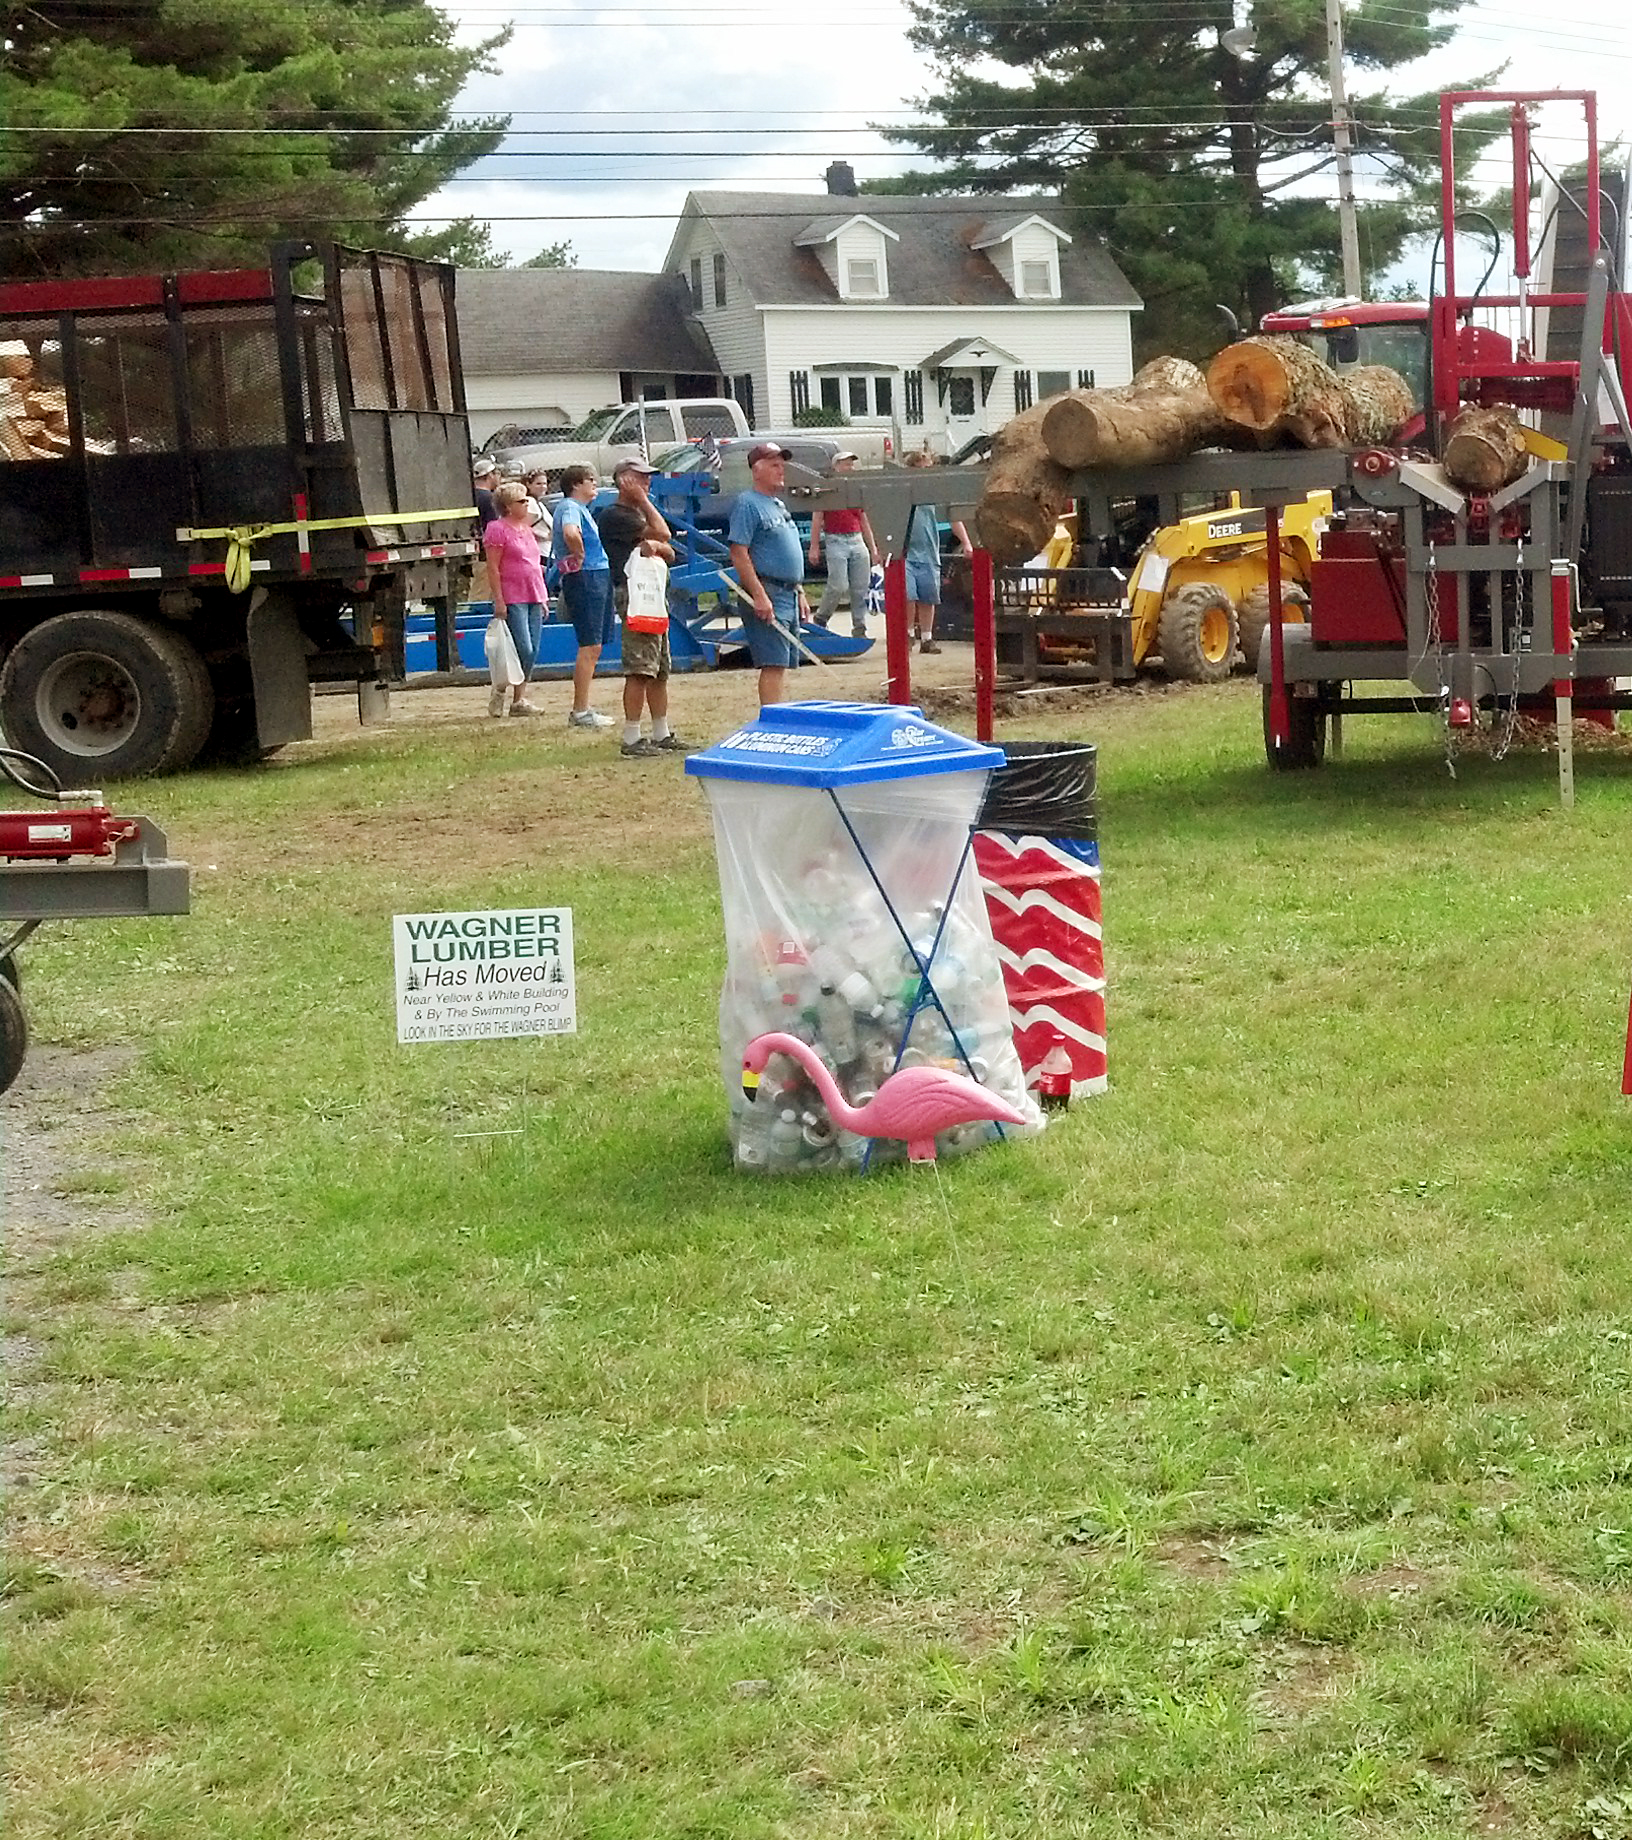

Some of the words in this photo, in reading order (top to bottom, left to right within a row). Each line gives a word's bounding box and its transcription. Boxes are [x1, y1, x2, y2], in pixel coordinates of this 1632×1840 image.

[1208, 522, 1242, 539] DEERE
[785, 734, 830, 746] BOTTLES
[405, 915, 561, 940] WAGNER
[411, 937, 560, 963] LUMBER
[424, 966, 467, 987] Has
[475, 961, 547, 985] Moved
[403, 995, 431, 1006] Near
[436, 992, 473, 1004] Yellow
[475, 991, 484, 1001] &
[488, 989, 520, 1001] White
[523, 987, 569, 999] Building
[414, 1010, 423, 1020] &
[426, 1008, 442, 1022] By
[446, 1007, 468, 1018] The
[471, 1004, 530, 1016] Swimming
[534, 1002, 560, 1013] Pool
[404, 1026, 426, 1040] LOOK
[428, 1025, 437, 1038] IN
[439, 1023, 455, 1037] THE
[456, 1022, 473, 1036] SKY
[474, 1021, 491, 1035] FOR
[493, 1020, 510, 1033] THE
[511, 1018, 546, 1033] WAGNER
